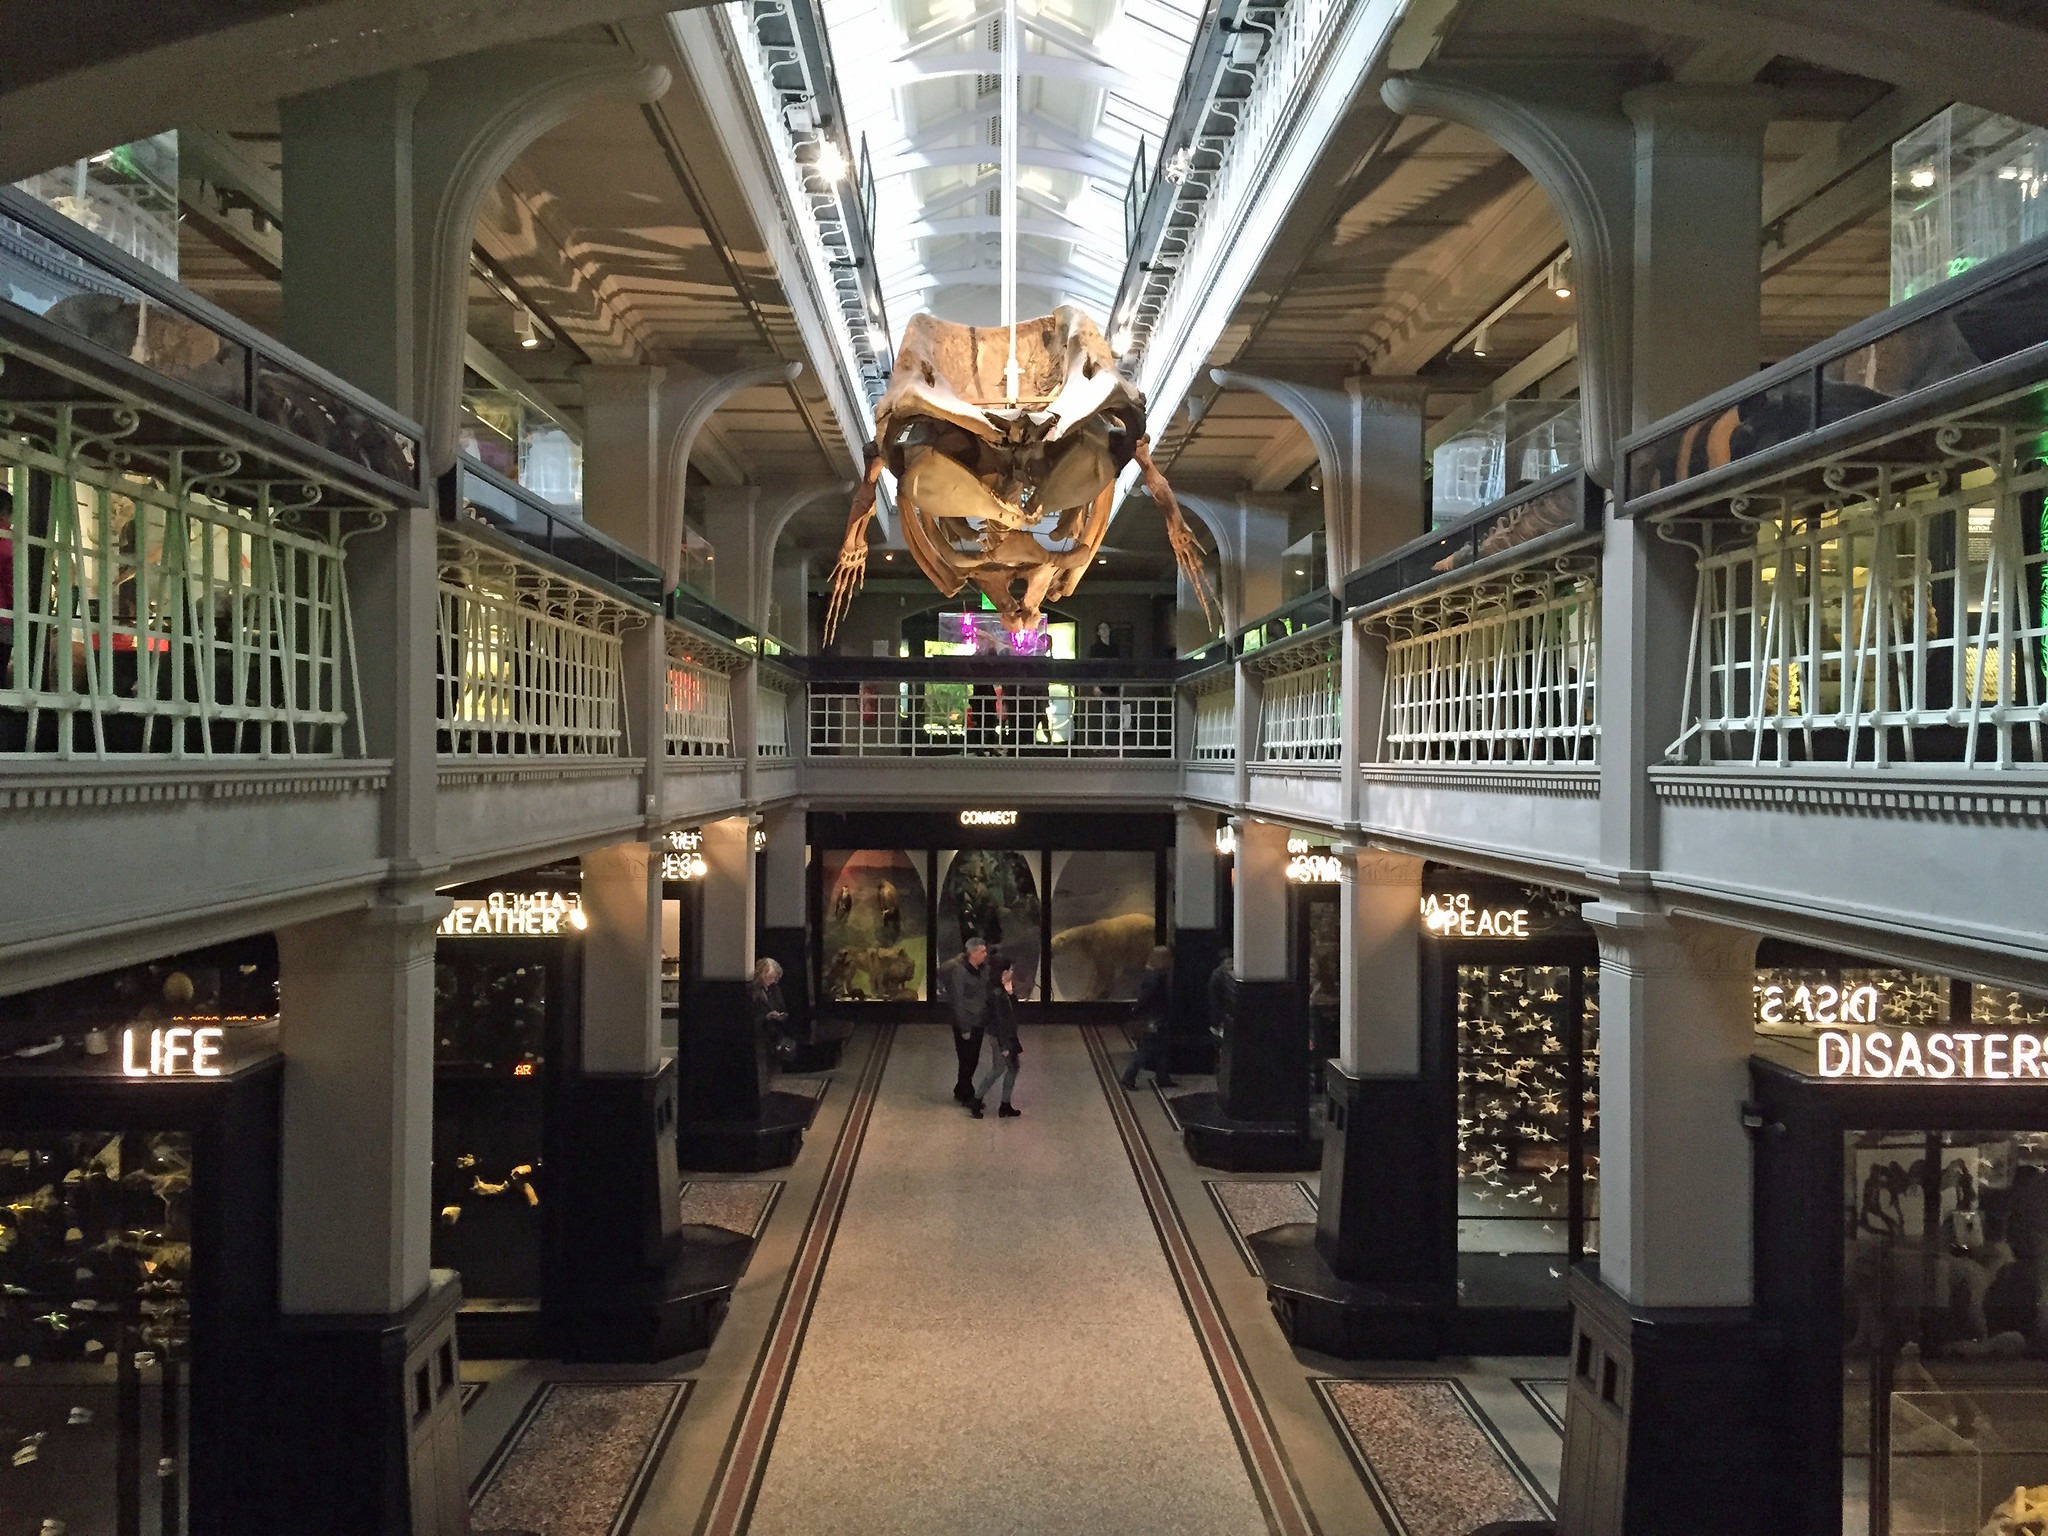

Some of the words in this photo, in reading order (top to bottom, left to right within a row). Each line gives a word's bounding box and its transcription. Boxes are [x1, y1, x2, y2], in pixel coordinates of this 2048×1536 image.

[960, 810, 1018, 825] CONNECT
[1442, 909, 1530, 936] PEACE
[122, 1028, 223, 1077] LIFE
[1817, 1031, 2048, 1079] DISASTER
